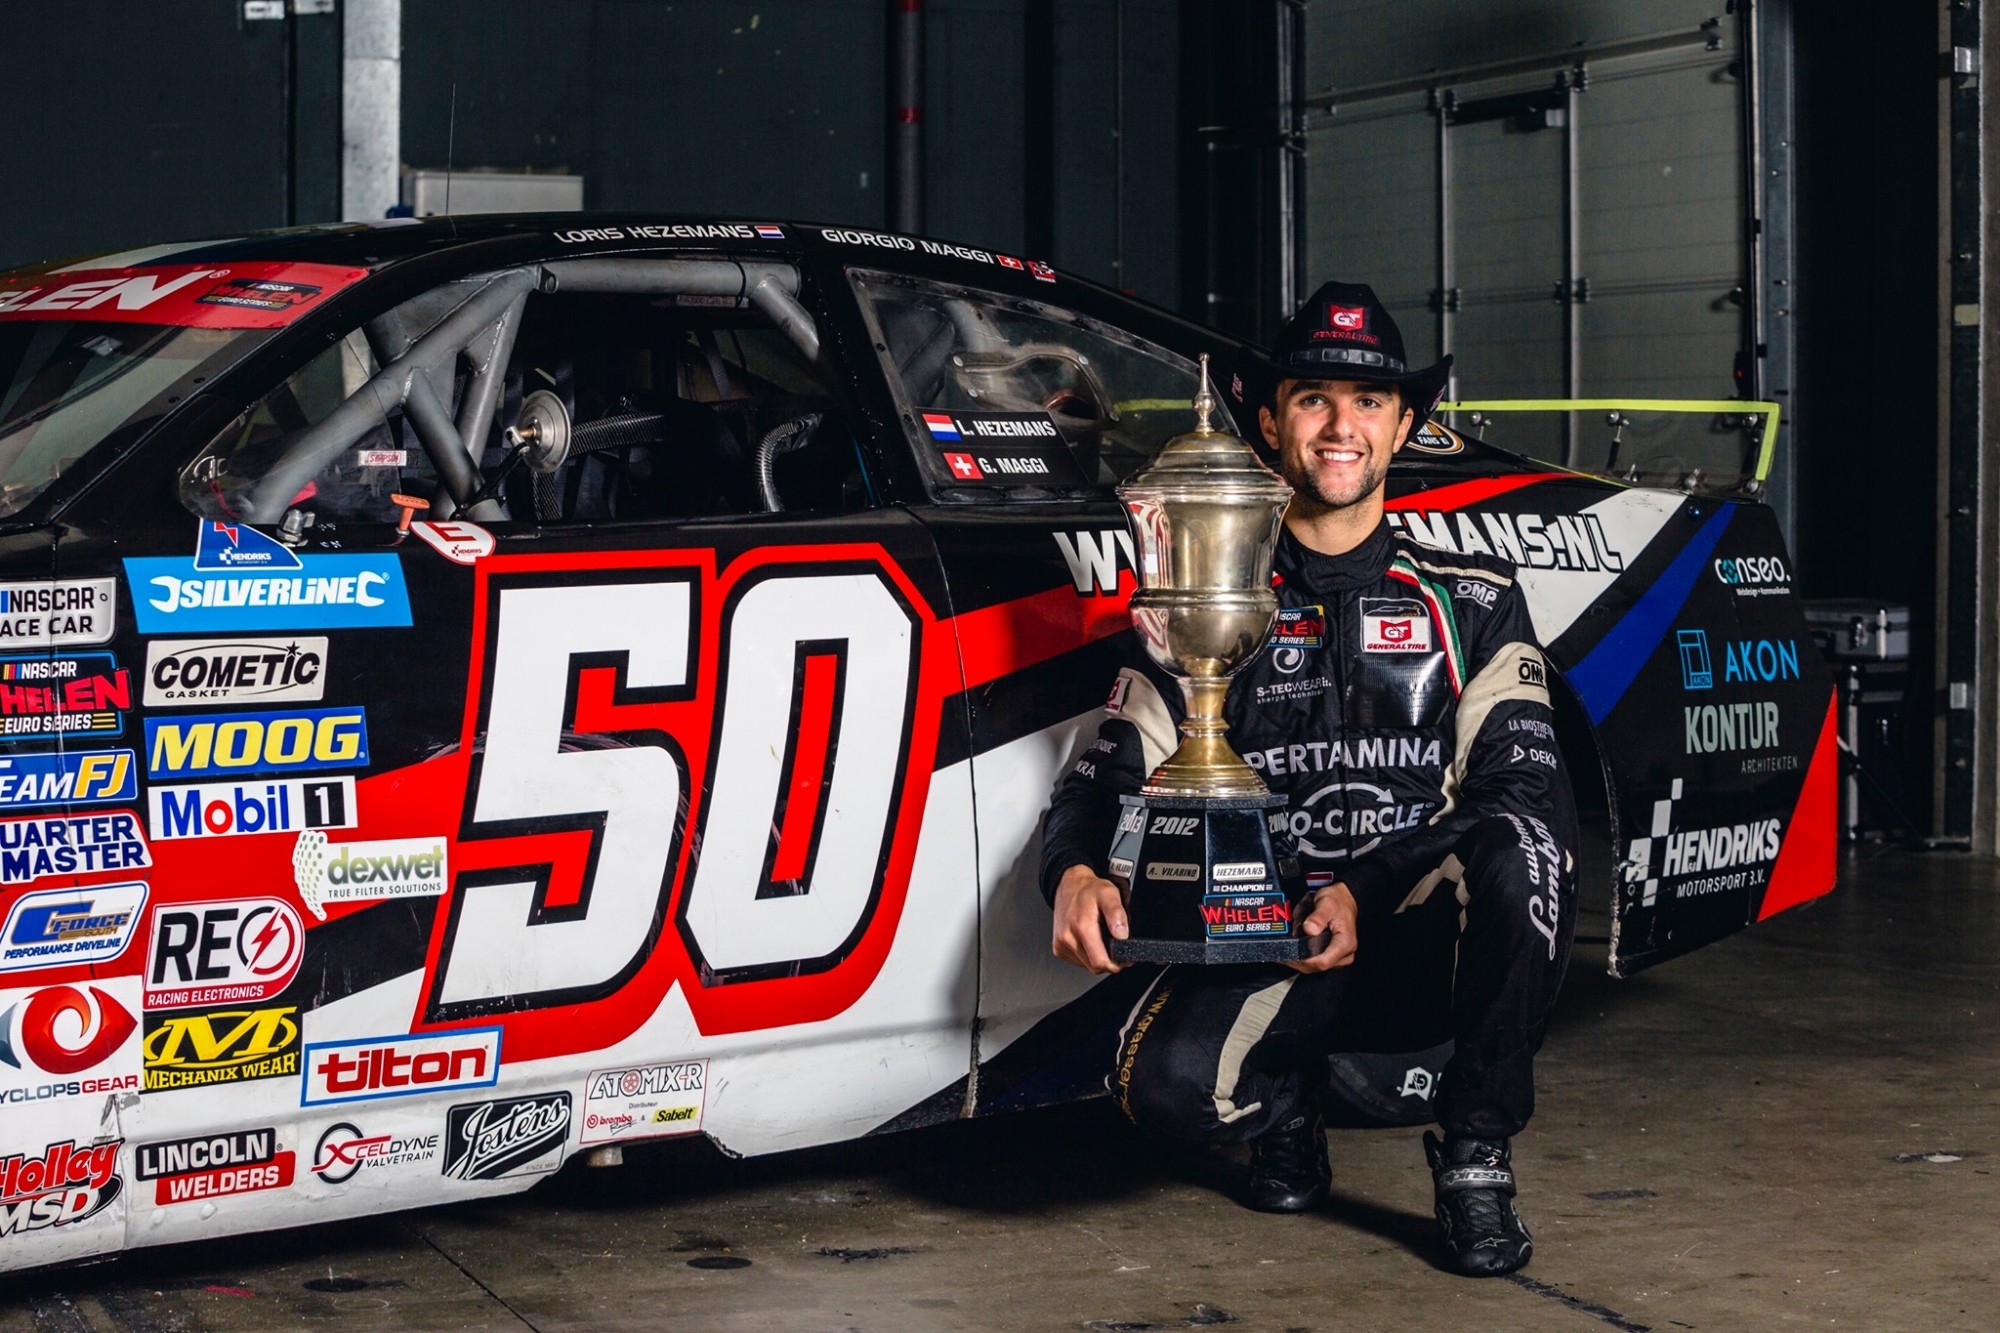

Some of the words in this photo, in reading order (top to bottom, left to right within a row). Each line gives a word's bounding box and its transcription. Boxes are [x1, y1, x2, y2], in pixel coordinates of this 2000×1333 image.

[554, 227, 624, 243] LORIS
[626, 225, 754, 238] HEZEMANS
[821, 229, 915, 251] GIORGIO
[920, 240, 994, 264] MAGGI
[1333, 311, 1361, 327] GT
[956, 420, 974, 436] L.
[973, 421, 1057, 437] HEZEMANS
[978, 458, 998, 474] G.
[996, 458, 1050, 474] MAGGI
[231, 553, 272, 561] HENDRIKS
[10, 586, 95, 613] NASCAR
[1456, 581, 1497, 603] OMP
[0, 618, 41, 638] ACE
[48, 616, 93, 635] CAR
[1274, 618, 1325, 636] ELEN
[1280, 613, 1301, 621] SCAR
[1279, 637, 1305, 645] SERIES
[1385, 626, 1408, 638] GT
[21, 661, 77, 680] NASCAR
[152, 650, 321, 691] COMETIC
[1725, 639, 1799, 682] AKON
[1256, 679, 1322, 697] S-TECWEAR
[1693, 675, 1711, 686] AKON
[0, 669, 131, 715] HELEN
[165, 689, 230, 699] GASKET
[4, 716, 40, 734] EURO
[43, 713, 93, 732] SERIES
[1508, 720, 1520, 731] LA
[1685, 702, 1779, 754] KONTUR
[150, 713, 363, 773] MOOG
[1243, 737, 1441, 776] PERTAMINA
[1741, 756, 1798, 774] ARCHITEKTEN
[438, 572, 913, 1006] 50
[161, 784, 291, 837] Mobil
[314, 786, 331, 826] 1
[1290, 802, 1424, 837] O-CIRCLE
[0, 815, 136, 849] UARTER
[1149, 816, 1200, 836] 2012
[1662, 818, 1781, 878] HENDRIKS
[2, 841, 146, 881] MASTER
[328, 845, 444, 885] dexwet
[1148, 867, 1158, 876] A.
[1216, 867, 1264, 877] HEZEMANS
[329, 888, 350, 898] TRUE
[356, 885, 384, 896] FILTER
[389, 882, 441, 894] SOLUTIONS
[1221, 884, 1265, 893] CHAMPION
[1677, 872, 1747, 898] MOTORSPORT
[1235, 897, 1264, 906] NASCAR
[1198, 901, 1291, 924] WHELEN
[85, 926, 118, 937] SOUTH
[1225, 924, 1244, 932] EURO
[1246, 922, 1271, 931] SERIES
[4, 943, 73, 959] PERFORMANCE
[75, 938, 121, 952] DRIVELINE
[148, 991, 189, 1006] RACING
[191, 985, 264, 1002] ELECTRONICS
[143, 1066, 238, 1091] MECHANIX
[242, 1051, 296, 1077] WEAR
[318, 1047, 487, 1093] tilton
[0, 1075, 138, 1104] YCLOPSGEAR
[589, 1063, 702, 1100] ATOMIX-R
[600, 1114, 632, 1125] brembo
[656, 1107, 693, 1122] Sabelt
[460, 1098, 570, 1178] Jostens
[142, 1131, 268, 1176] LINCOLN
[366, 1149, 434, 1168] VALVETRAIN
[170, 1165, 279, 1201] WELDERS
